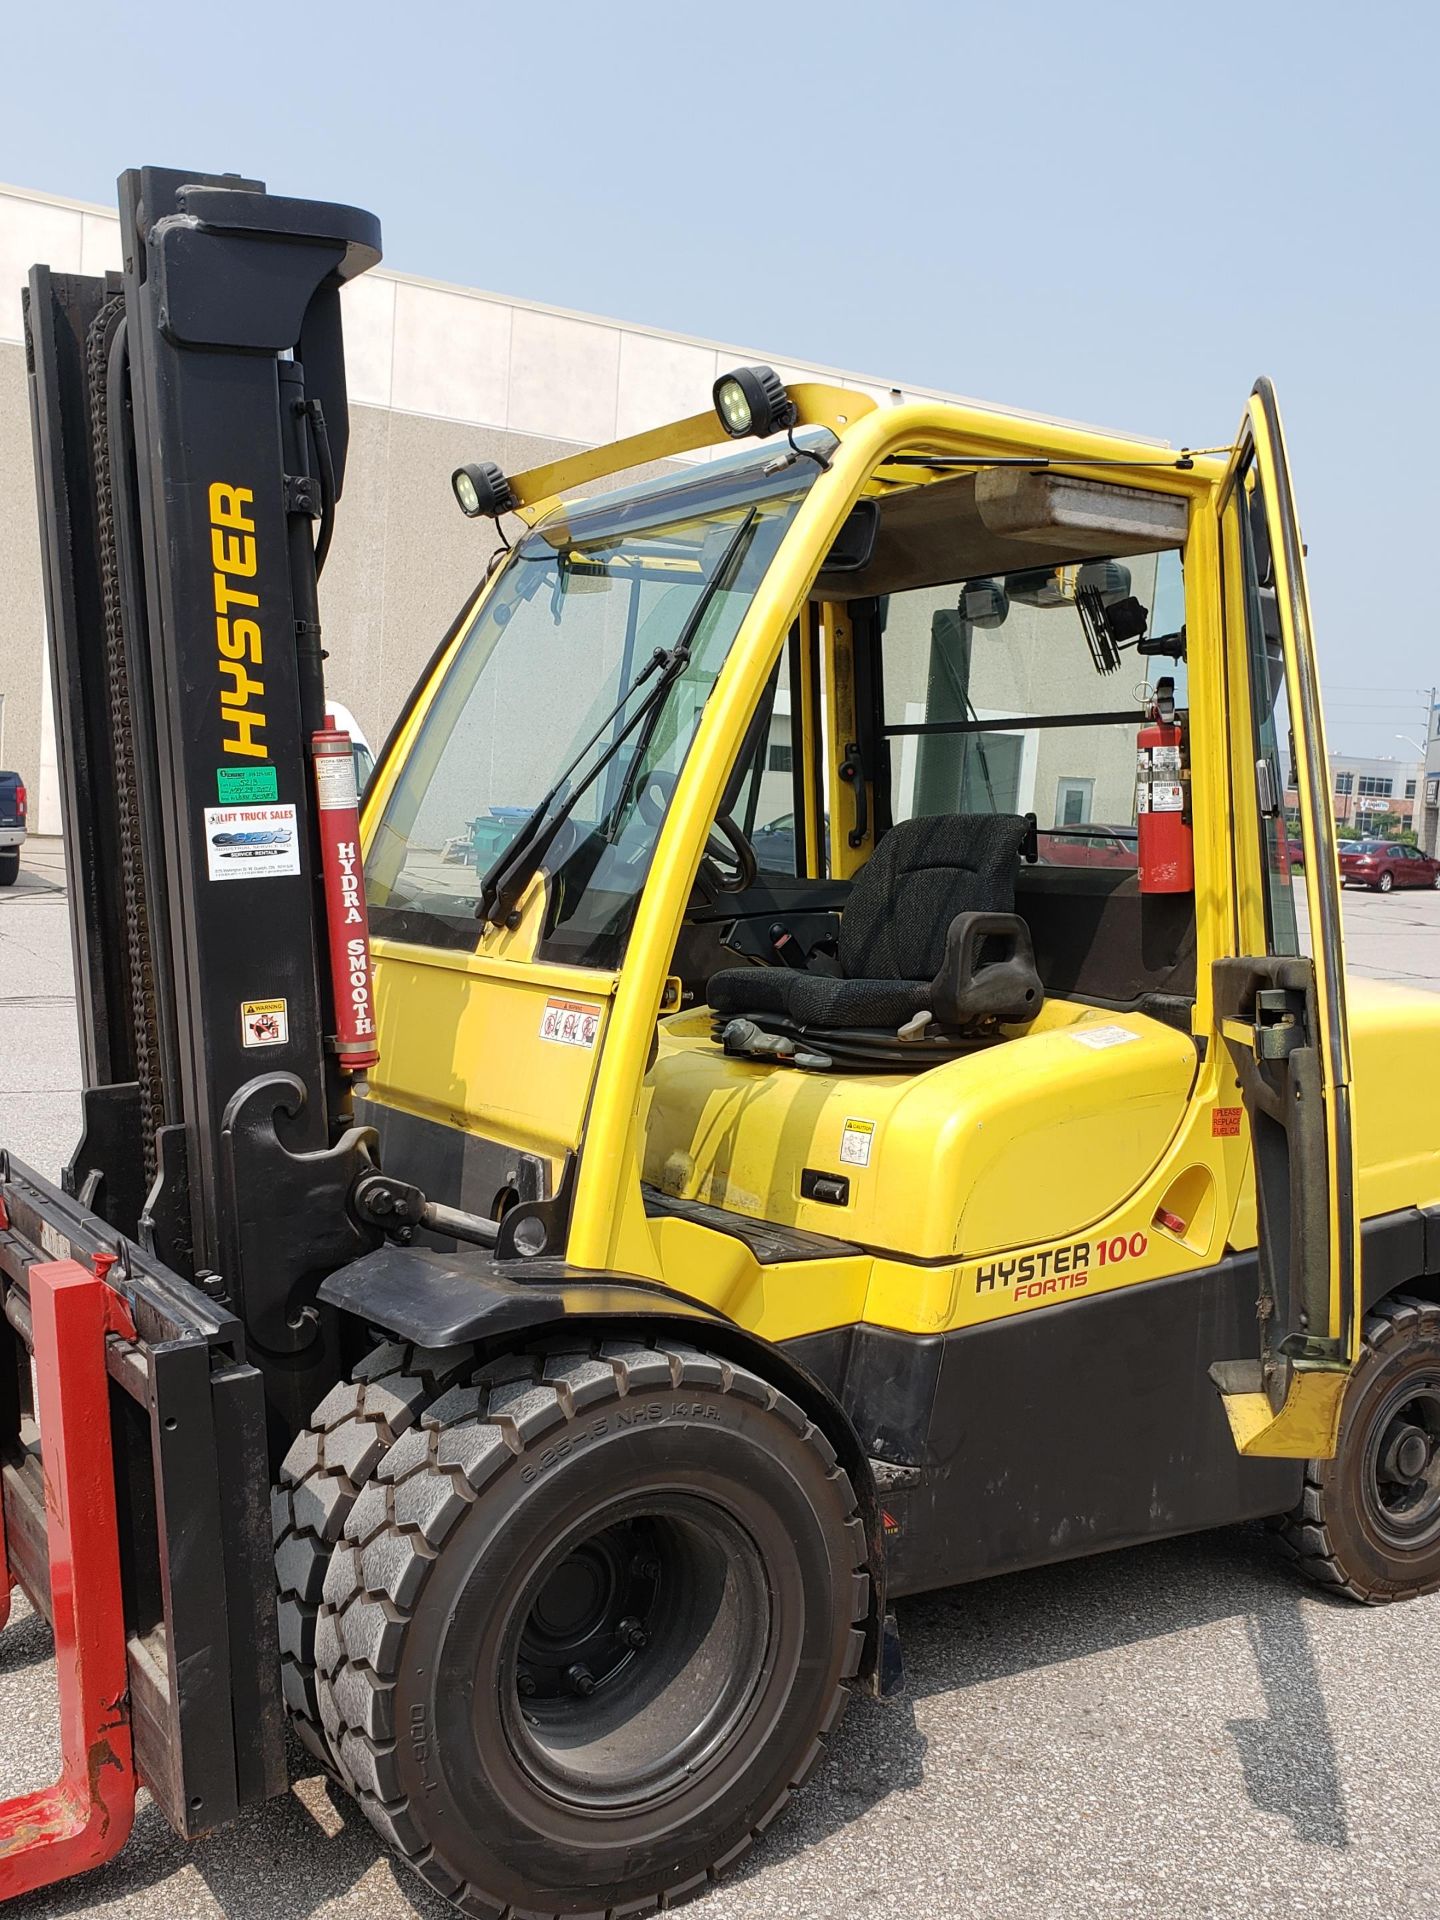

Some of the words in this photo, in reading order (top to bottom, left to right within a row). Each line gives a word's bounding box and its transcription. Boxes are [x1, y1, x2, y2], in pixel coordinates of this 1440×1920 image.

[208, 482, 268, 759] HYSTER
[219, 813, 237, 823] LIFT
[240, 811, 268, 822] TRUCK
[270, 810, 294, 820] SALES
[337, 842, 362, 924] HYDRA
[347, 939, 372, 1036] SMOOTH
[255, 1003, 282, 1012] WARNING
[852, 1123, 872, 1131] CAUTION
[976, 1242, 1090, 1293] HYSTER
[1097, 1231, 1148, 1266] 100
[1014, 1271, 1088, 1302] FORTIS
[615, 1402, 663, 1427] NHS
